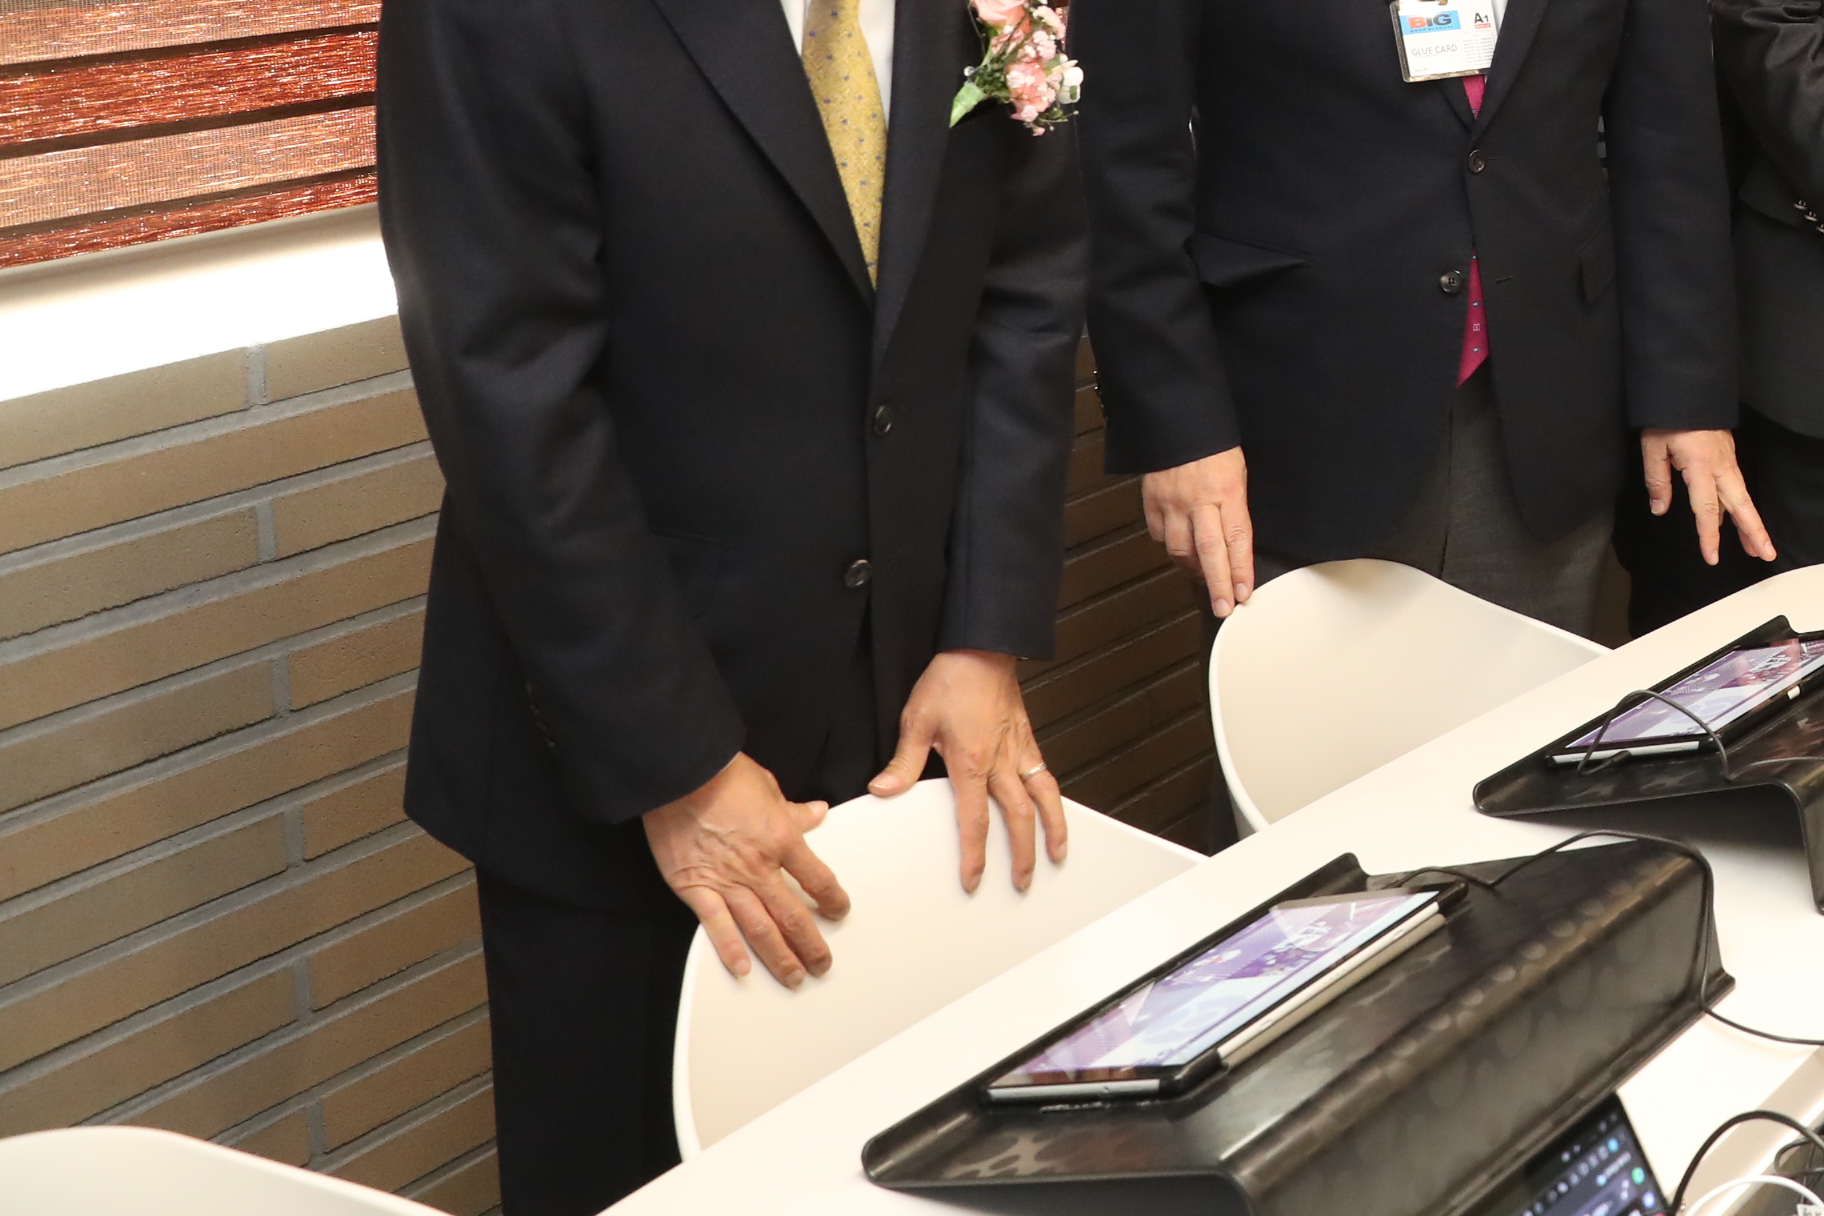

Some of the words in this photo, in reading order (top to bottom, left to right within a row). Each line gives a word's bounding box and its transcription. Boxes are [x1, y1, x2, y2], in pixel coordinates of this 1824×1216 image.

[1474, 13, 1489, 24] A1
[1411, 46, 1433, 56] GLUE
[1435, 44, 1458, 54] CARD
